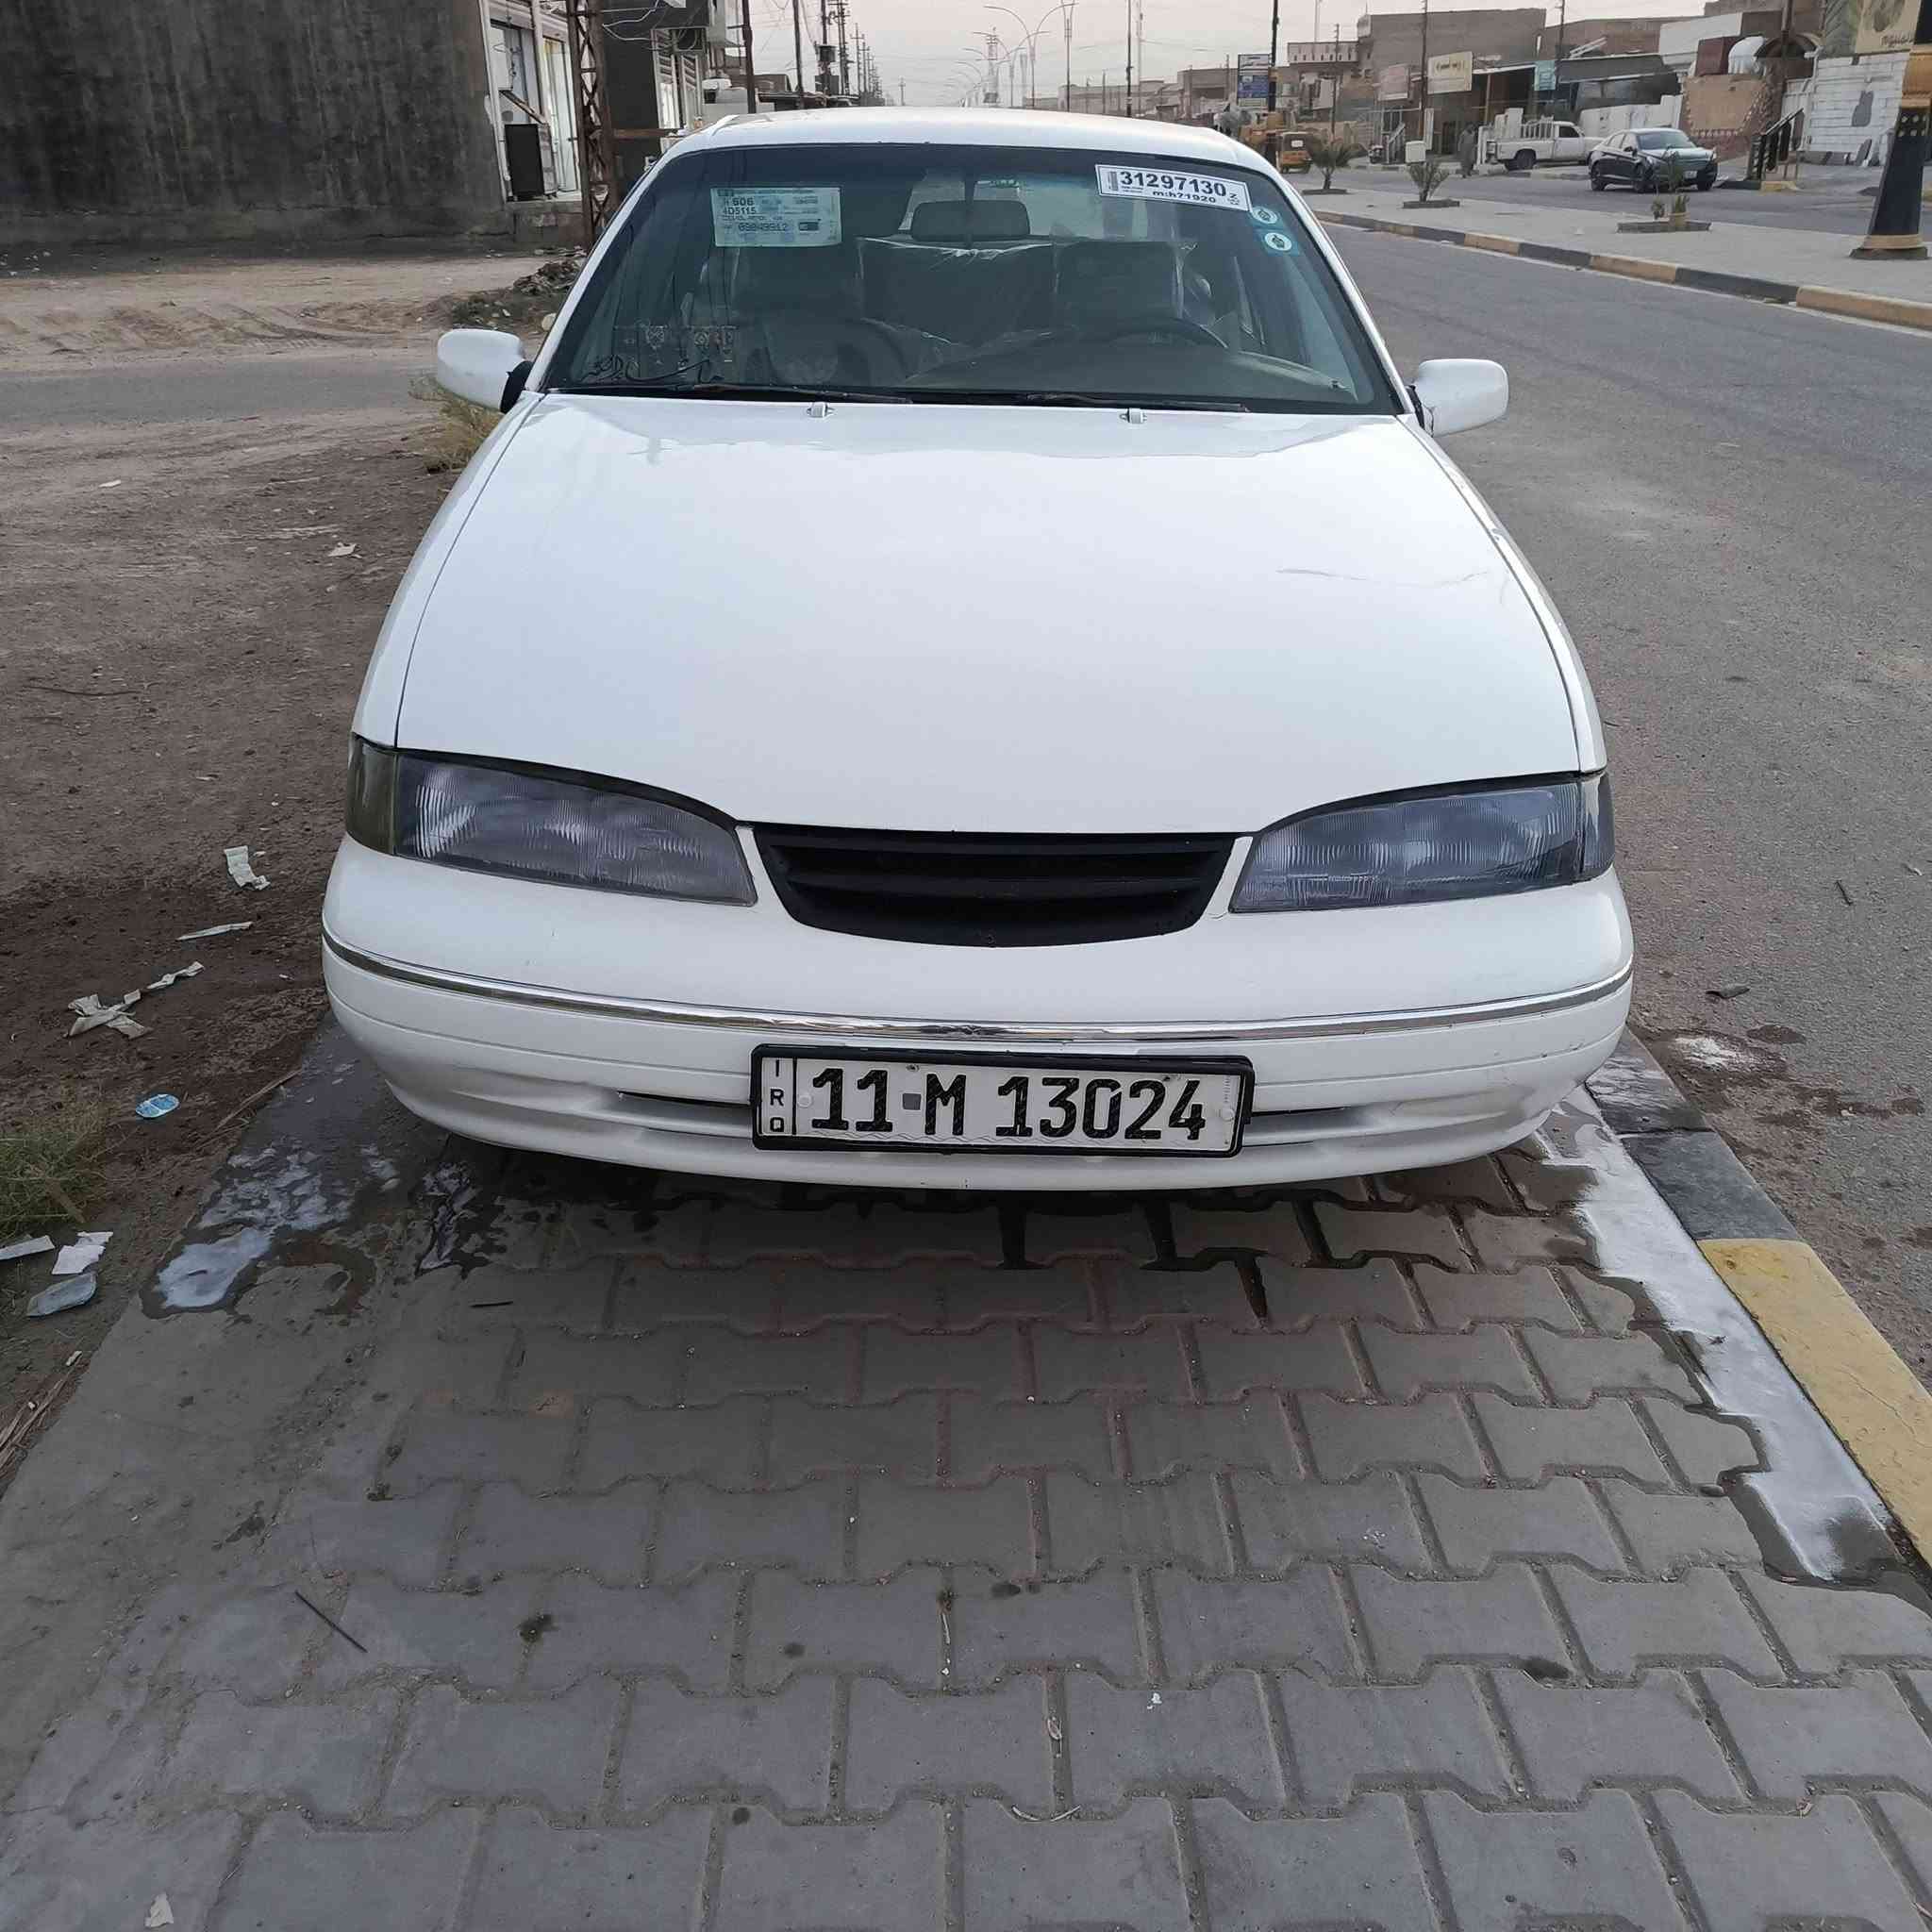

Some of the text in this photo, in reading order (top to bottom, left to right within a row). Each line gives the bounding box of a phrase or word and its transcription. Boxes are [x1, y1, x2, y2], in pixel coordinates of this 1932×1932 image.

[1120, 171, 1226, 196] 31297130
[770, 1058, 785, 1132] IRQ
[811, 1068, 1206, 1140] 11 M 13024
